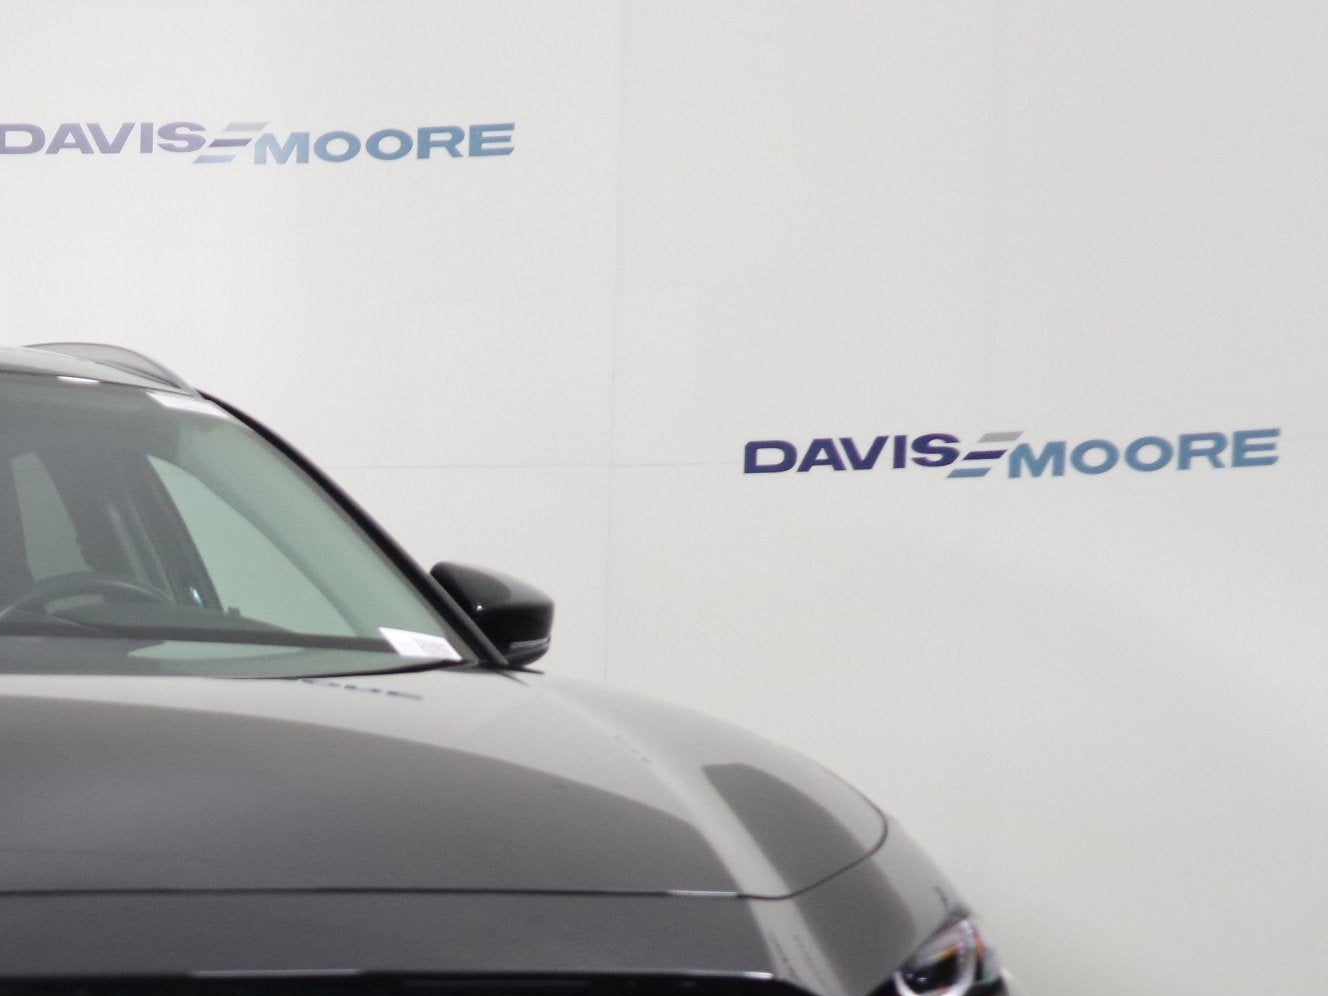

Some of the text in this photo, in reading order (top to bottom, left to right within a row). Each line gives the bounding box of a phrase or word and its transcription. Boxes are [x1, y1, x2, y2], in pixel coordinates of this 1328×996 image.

[253, 122, 515, 166] MOORE
[743, 427, 1282, 480] DAVIS MOORE
